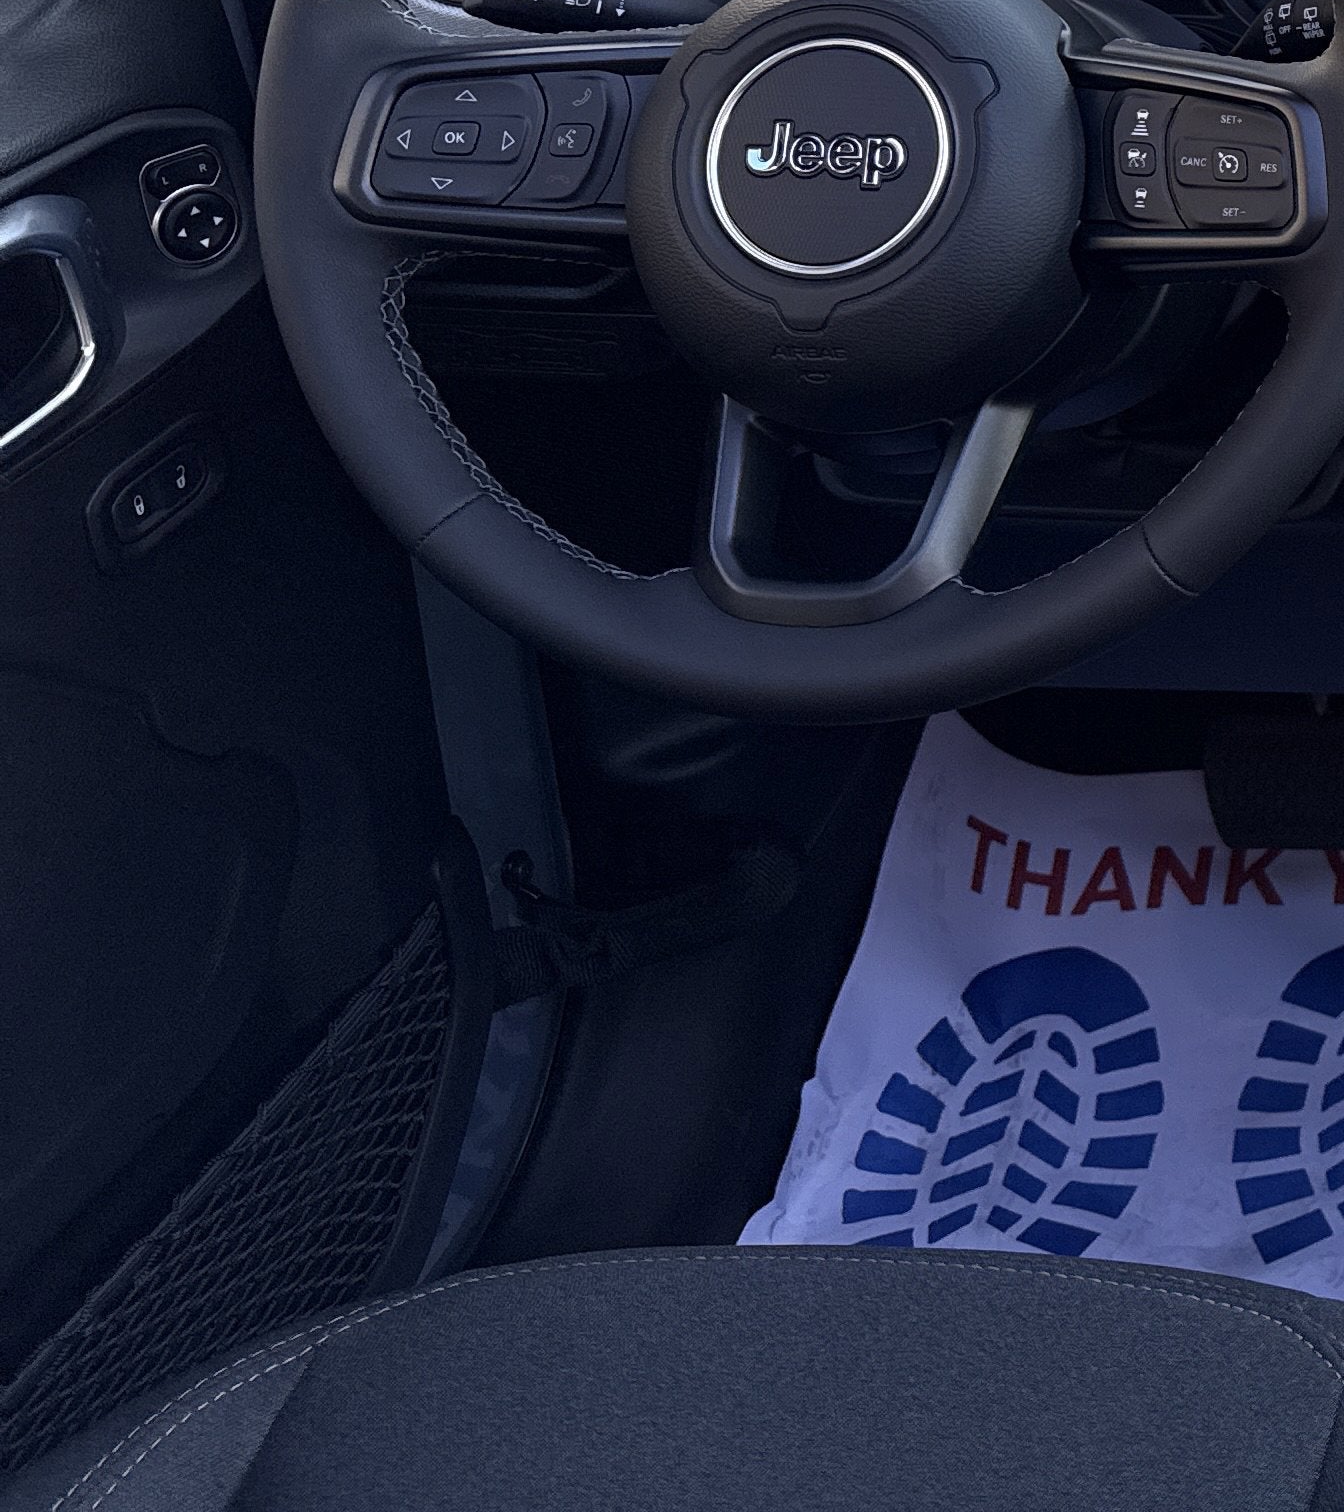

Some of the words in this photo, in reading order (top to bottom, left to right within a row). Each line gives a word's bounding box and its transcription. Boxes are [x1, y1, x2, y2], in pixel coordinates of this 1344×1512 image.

[1279, 25, 1291, 34] OFF
[1302, 29, 1325, 39] WIPER
[444, 130, 466, 145] OK
[745, 120, 908, 190] Jeep
[1180, 155, 1207, 168] CANC
[198, 162, 208, 173] R
[1260, 161, 1278, 174] RES
[966, 815, 1286, 916] THANK
